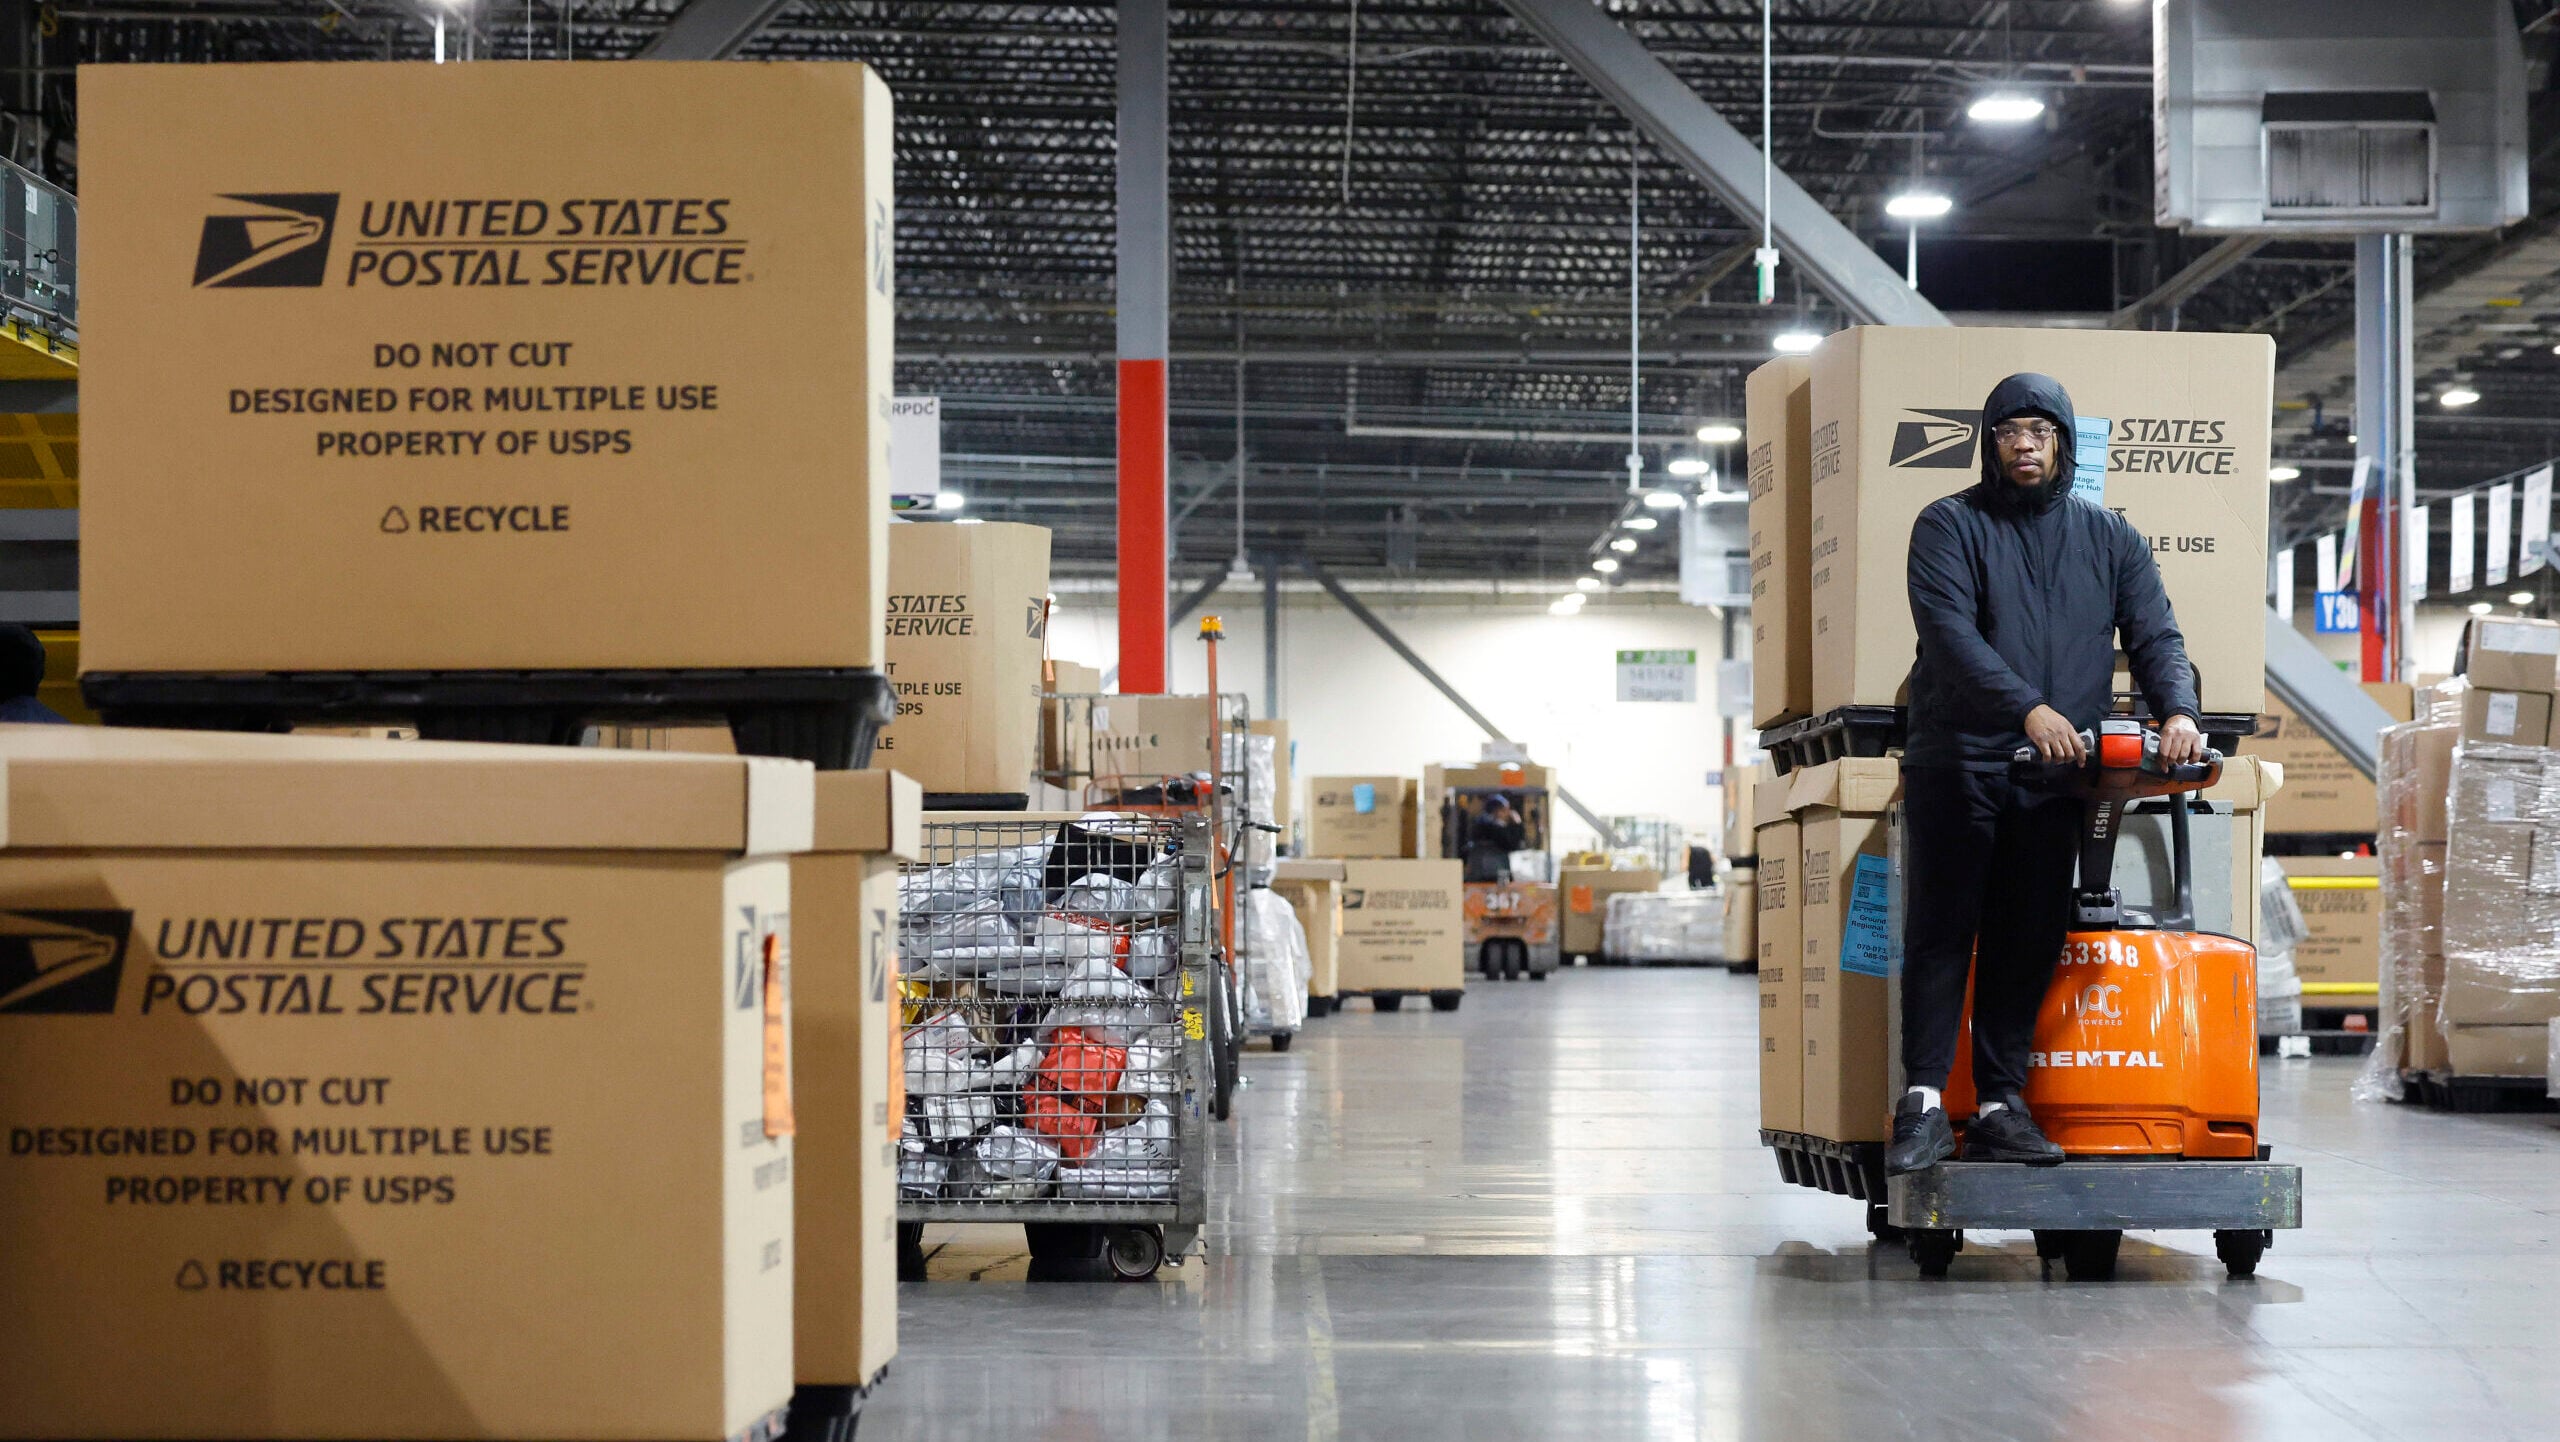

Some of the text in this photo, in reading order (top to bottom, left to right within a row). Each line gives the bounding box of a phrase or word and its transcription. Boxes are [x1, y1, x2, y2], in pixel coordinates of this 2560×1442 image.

[360, 199, 731, 238] UNITED STATES
[347, 249, 746, 288] POSTAL SERVICE
[374, 342, 573, 368] DO NOT CUT
[229, 384, 718, 414] DESIGNED FOR MULTIPLE USE
[316, 429, 632, 456] PROPERTY OF USPS
[2117, 418, 2226, 444] STATES
[2107, 449, 2235, 475] SERVICE
[419, 504, 571, 532] RECYCLE
[2177, 536, 2215, 553] USE
[887, 594, 967, 613] STATES
[934, 682, 962, 695] USE
[1851, 920, 1883, 931] Regional
[1859, 914, 1887, 924] Ground
[157, 917, 569, 959] UNITED STATES
[140, 973, 585, 1015] POSTAL SERVICE
[2027, 1051, 2164, 1067] RENTAL
[171, 1077, 391, 1106] DO NOT CUT
[10, 1126, 553, 1156] DESIGNED FOR MULTIPLE USE
[105, 1174, 456, 1205] PROPERTY OF USPS
[218, 1259, 387, 1290] RECYCLE
